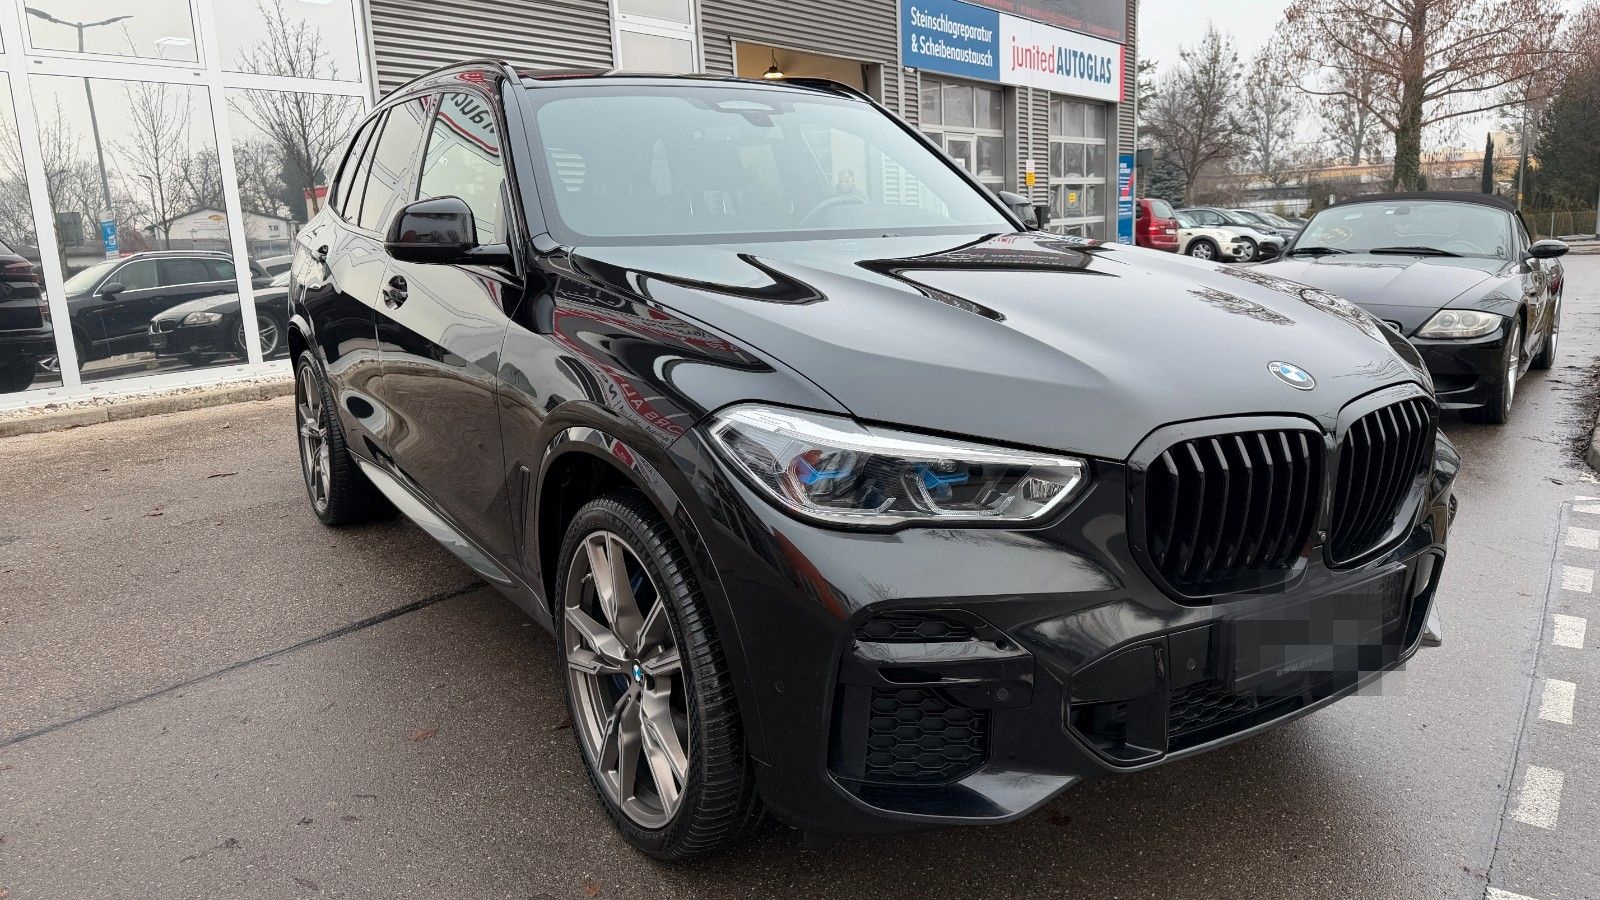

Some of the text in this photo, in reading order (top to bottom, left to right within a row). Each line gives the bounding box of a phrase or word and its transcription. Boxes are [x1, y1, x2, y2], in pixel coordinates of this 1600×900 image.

[911, 6, 993, 42] Steinschlagreparatur
[911, 33, 993, 67] & Scheibenaustausch
